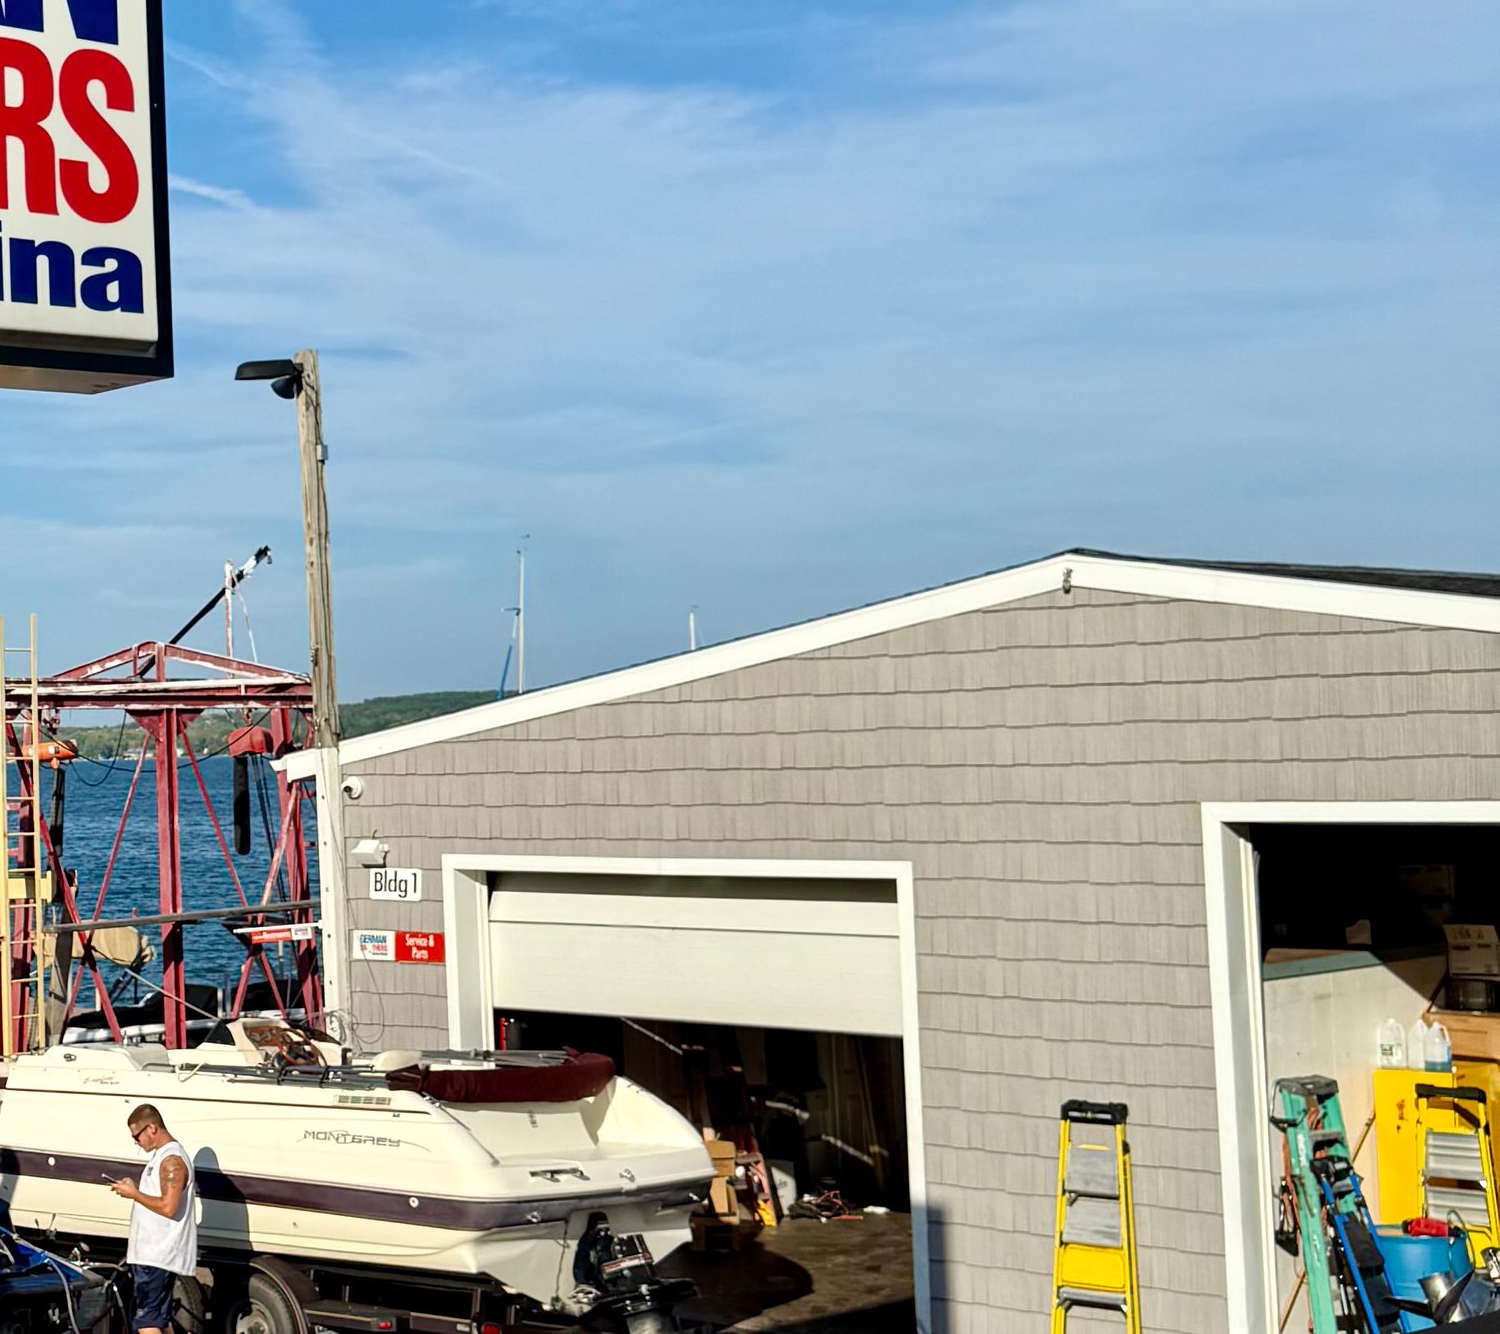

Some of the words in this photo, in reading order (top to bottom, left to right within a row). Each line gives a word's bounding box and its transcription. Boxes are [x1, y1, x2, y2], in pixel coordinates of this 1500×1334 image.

[373, 870, 409, 898] Bldg
[411, 872, 418, 894] 1
[405, 933, 428, 947] Service
[411, 946, 430, 960] Parts
[303, 1130, 401, 1147] MONTEREY
